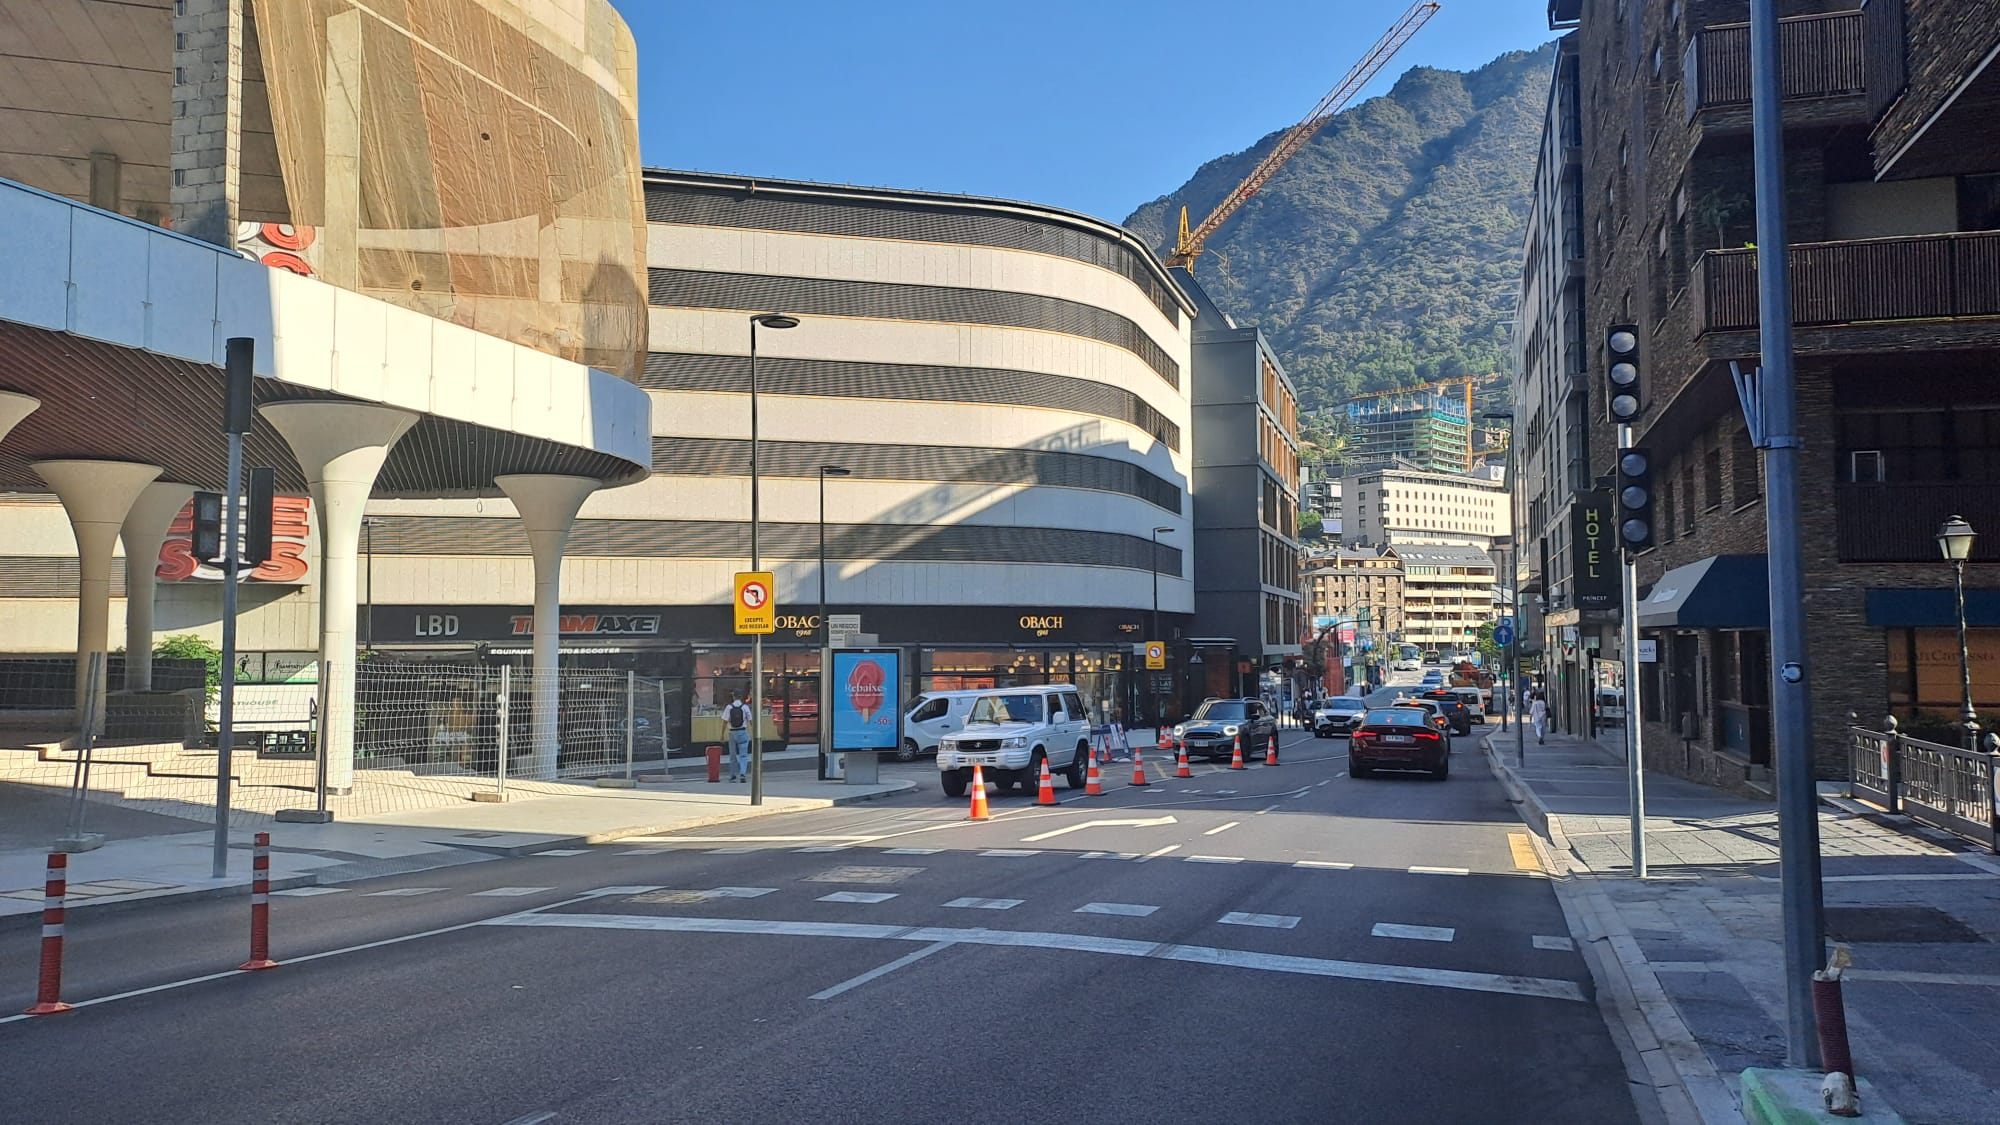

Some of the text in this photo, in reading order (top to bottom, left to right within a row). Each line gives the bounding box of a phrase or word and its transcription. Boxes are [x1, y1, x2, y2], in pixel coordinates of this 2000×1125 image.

[1585, 508, 1600, 578] HOTEL
[415, 614, 459, 636] LBD
[775, 615, 820, 629] OBAC
[1020, 616, 1063, 629] OBACH
